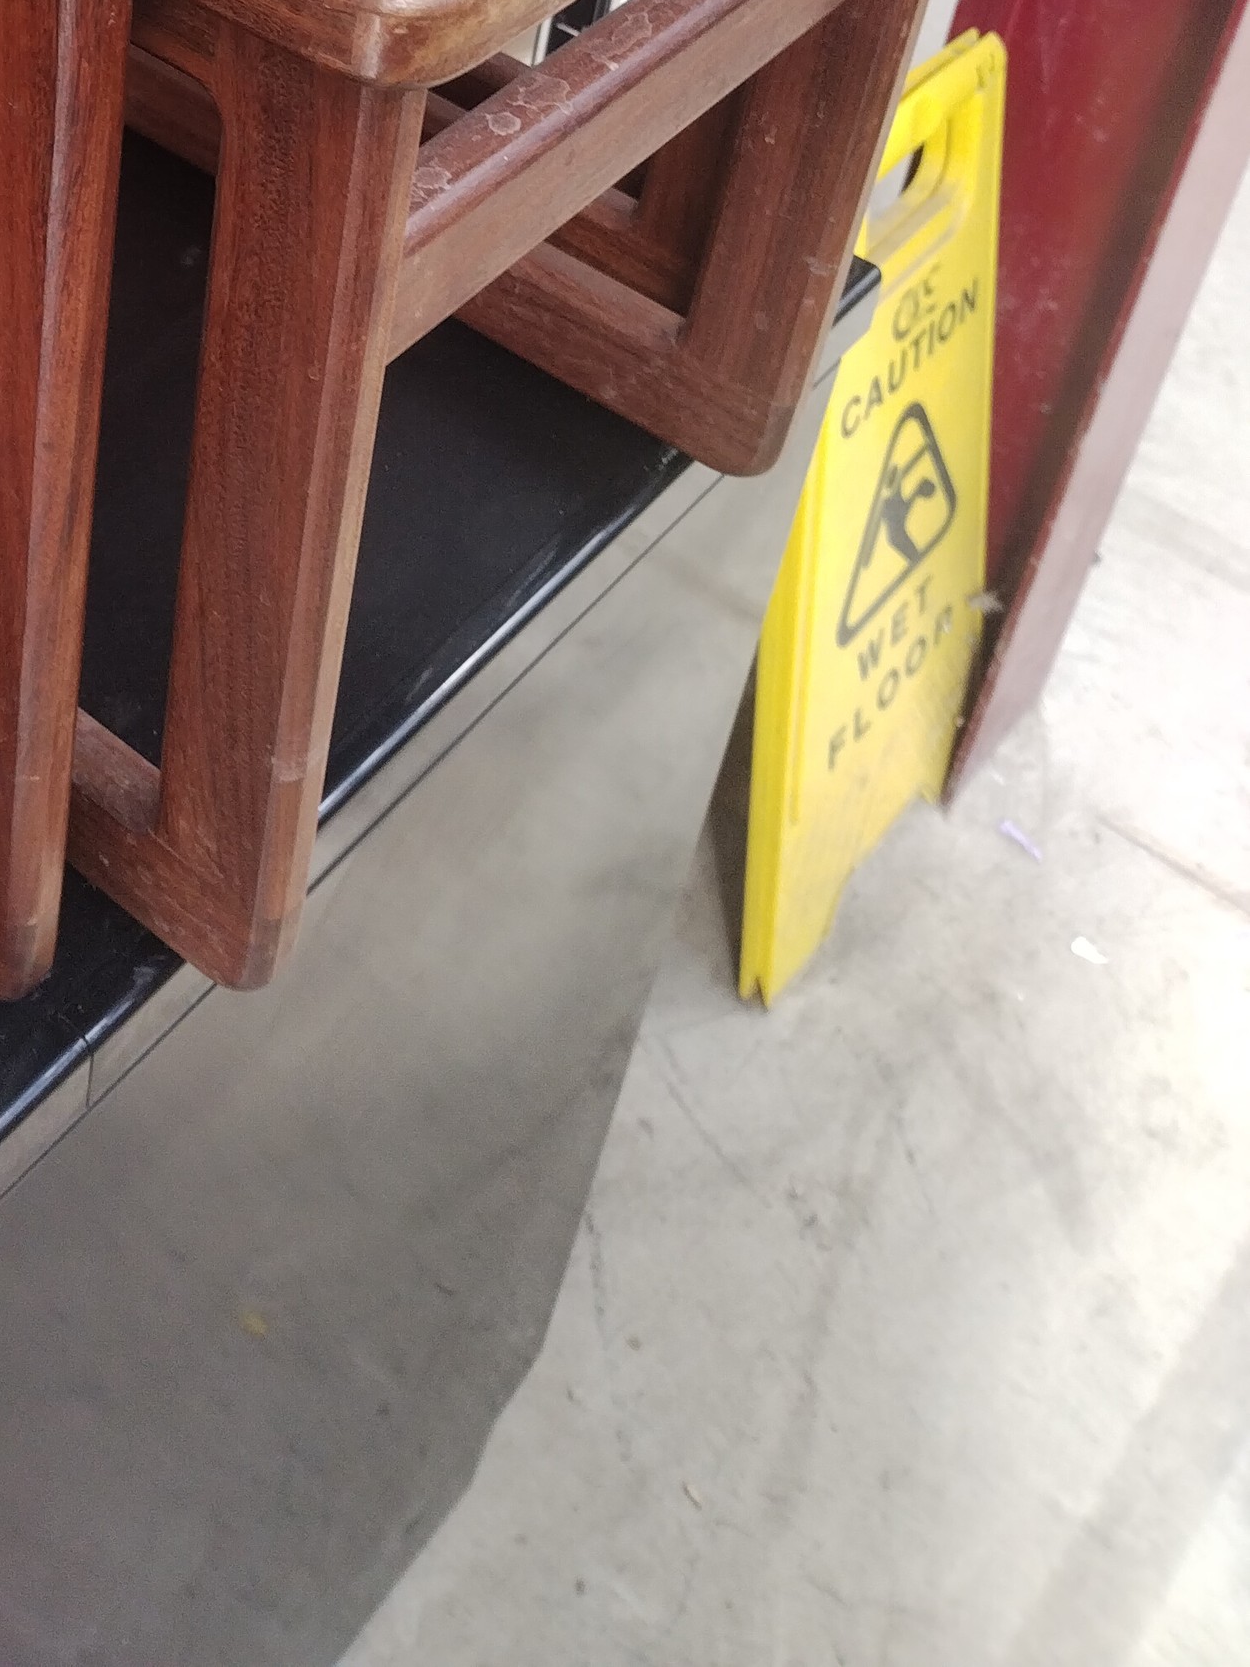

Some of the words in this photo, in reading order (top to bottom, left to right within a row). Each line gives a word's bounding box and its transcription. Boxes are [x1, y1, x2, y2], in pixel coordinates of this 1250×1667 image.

[840, 277, 979, 439] CAUTION
[827, 604, 954, 772] FLOOR
[857, 575, 933, 680] WET
